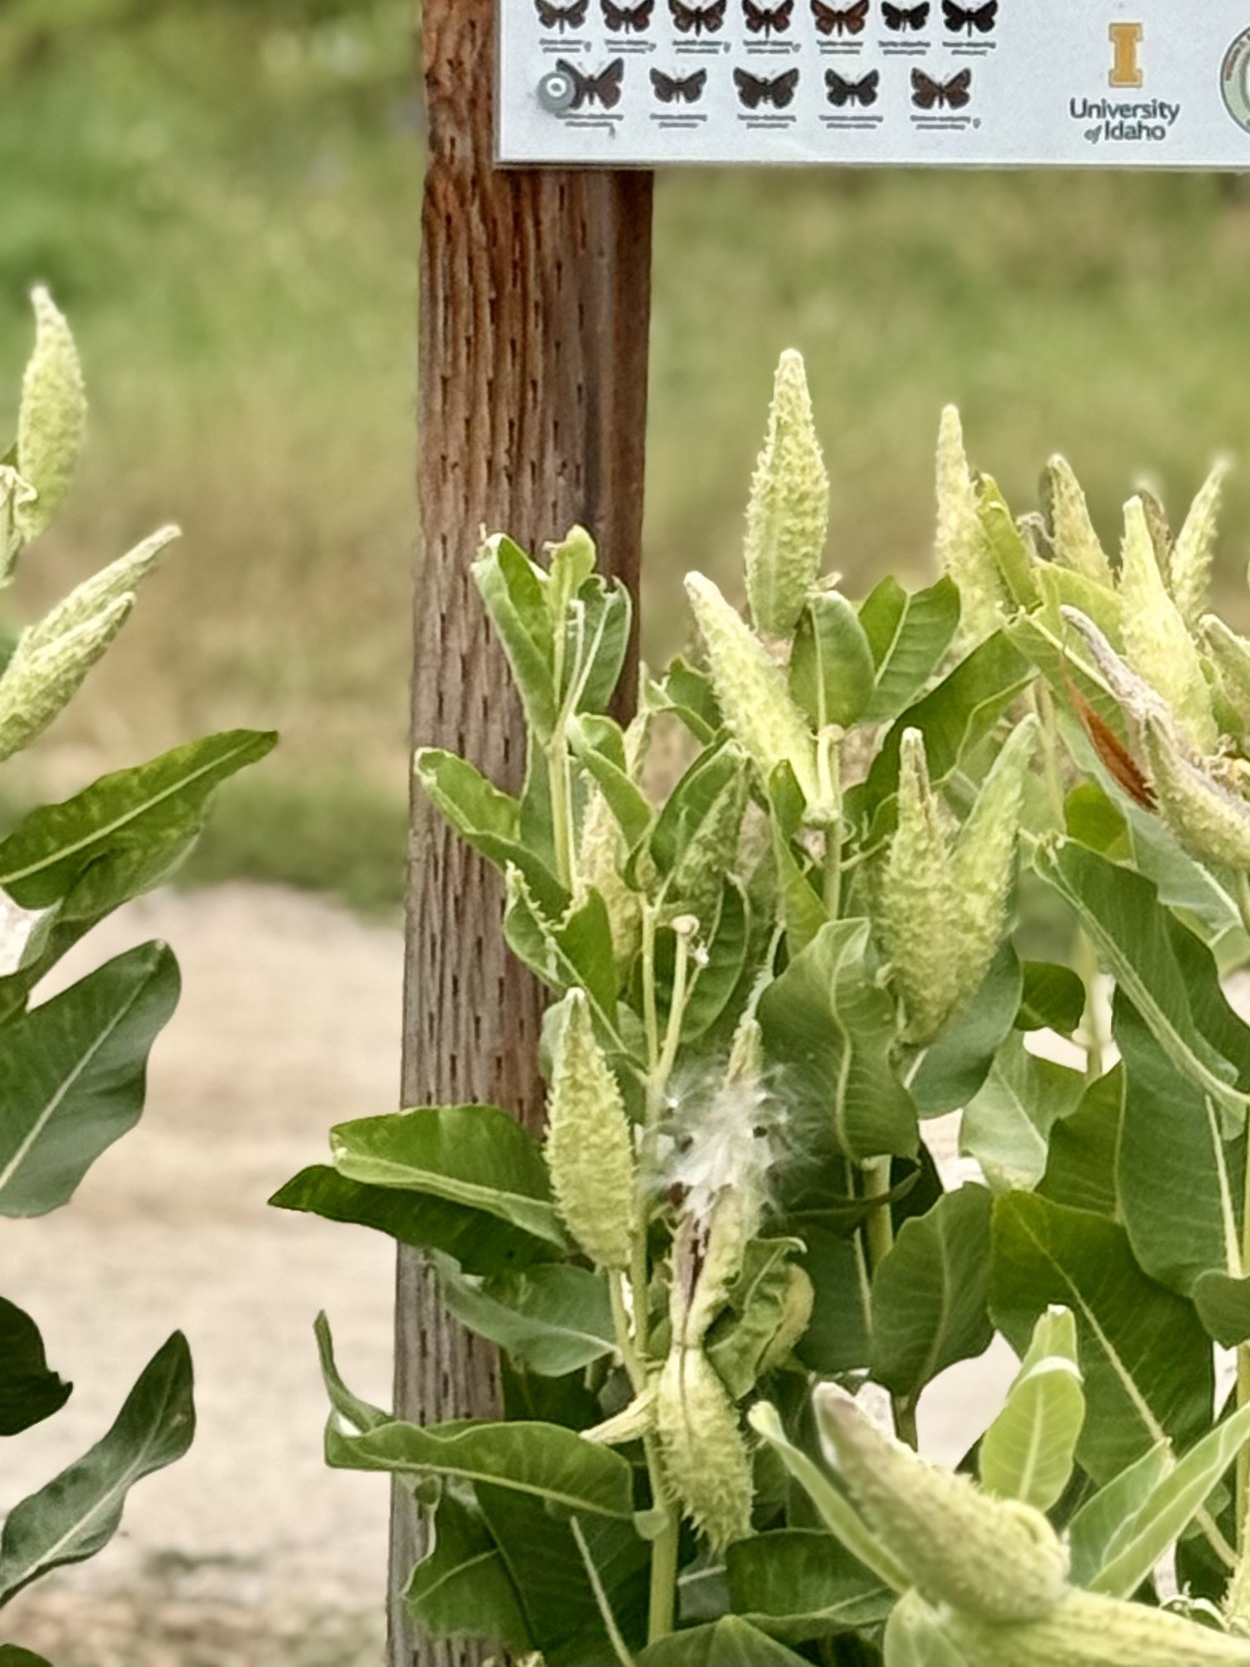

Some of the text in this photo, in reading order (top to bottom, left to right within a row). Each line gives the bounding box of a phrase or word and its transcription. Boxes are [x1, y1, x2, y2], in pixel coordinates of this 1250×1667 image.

[1069, 98, 1181, 126] University
[1084, 121, 1166, 145] of Idaho
